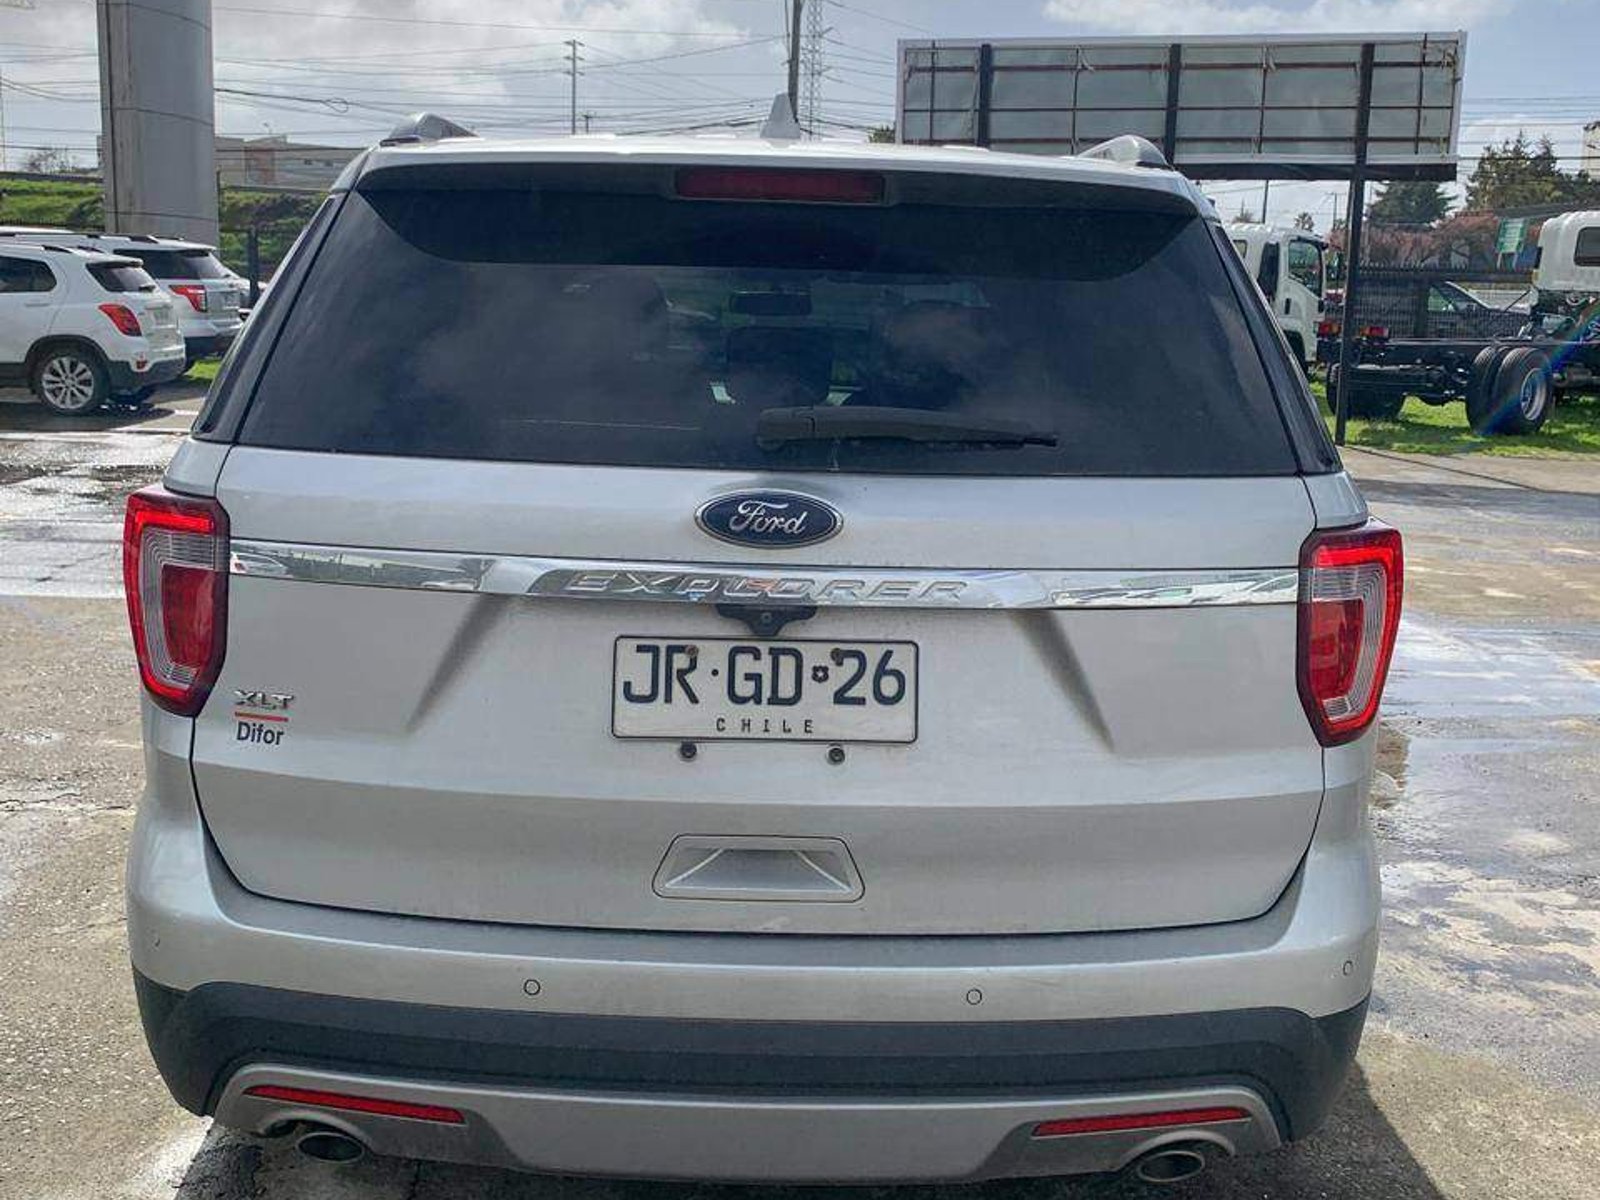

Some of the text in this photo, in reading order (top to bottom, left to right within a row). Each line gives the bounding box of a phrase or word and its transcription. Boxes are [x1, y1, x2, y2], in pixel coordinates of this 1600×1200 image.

[729, 499, 808, 536] Ford
[564, 568, 969, 602] EXPLORER
[233, 688, 295, 710] XLT
[236, 721, 285, 746] Difor
[716, 717, 815, 734] CHILE
